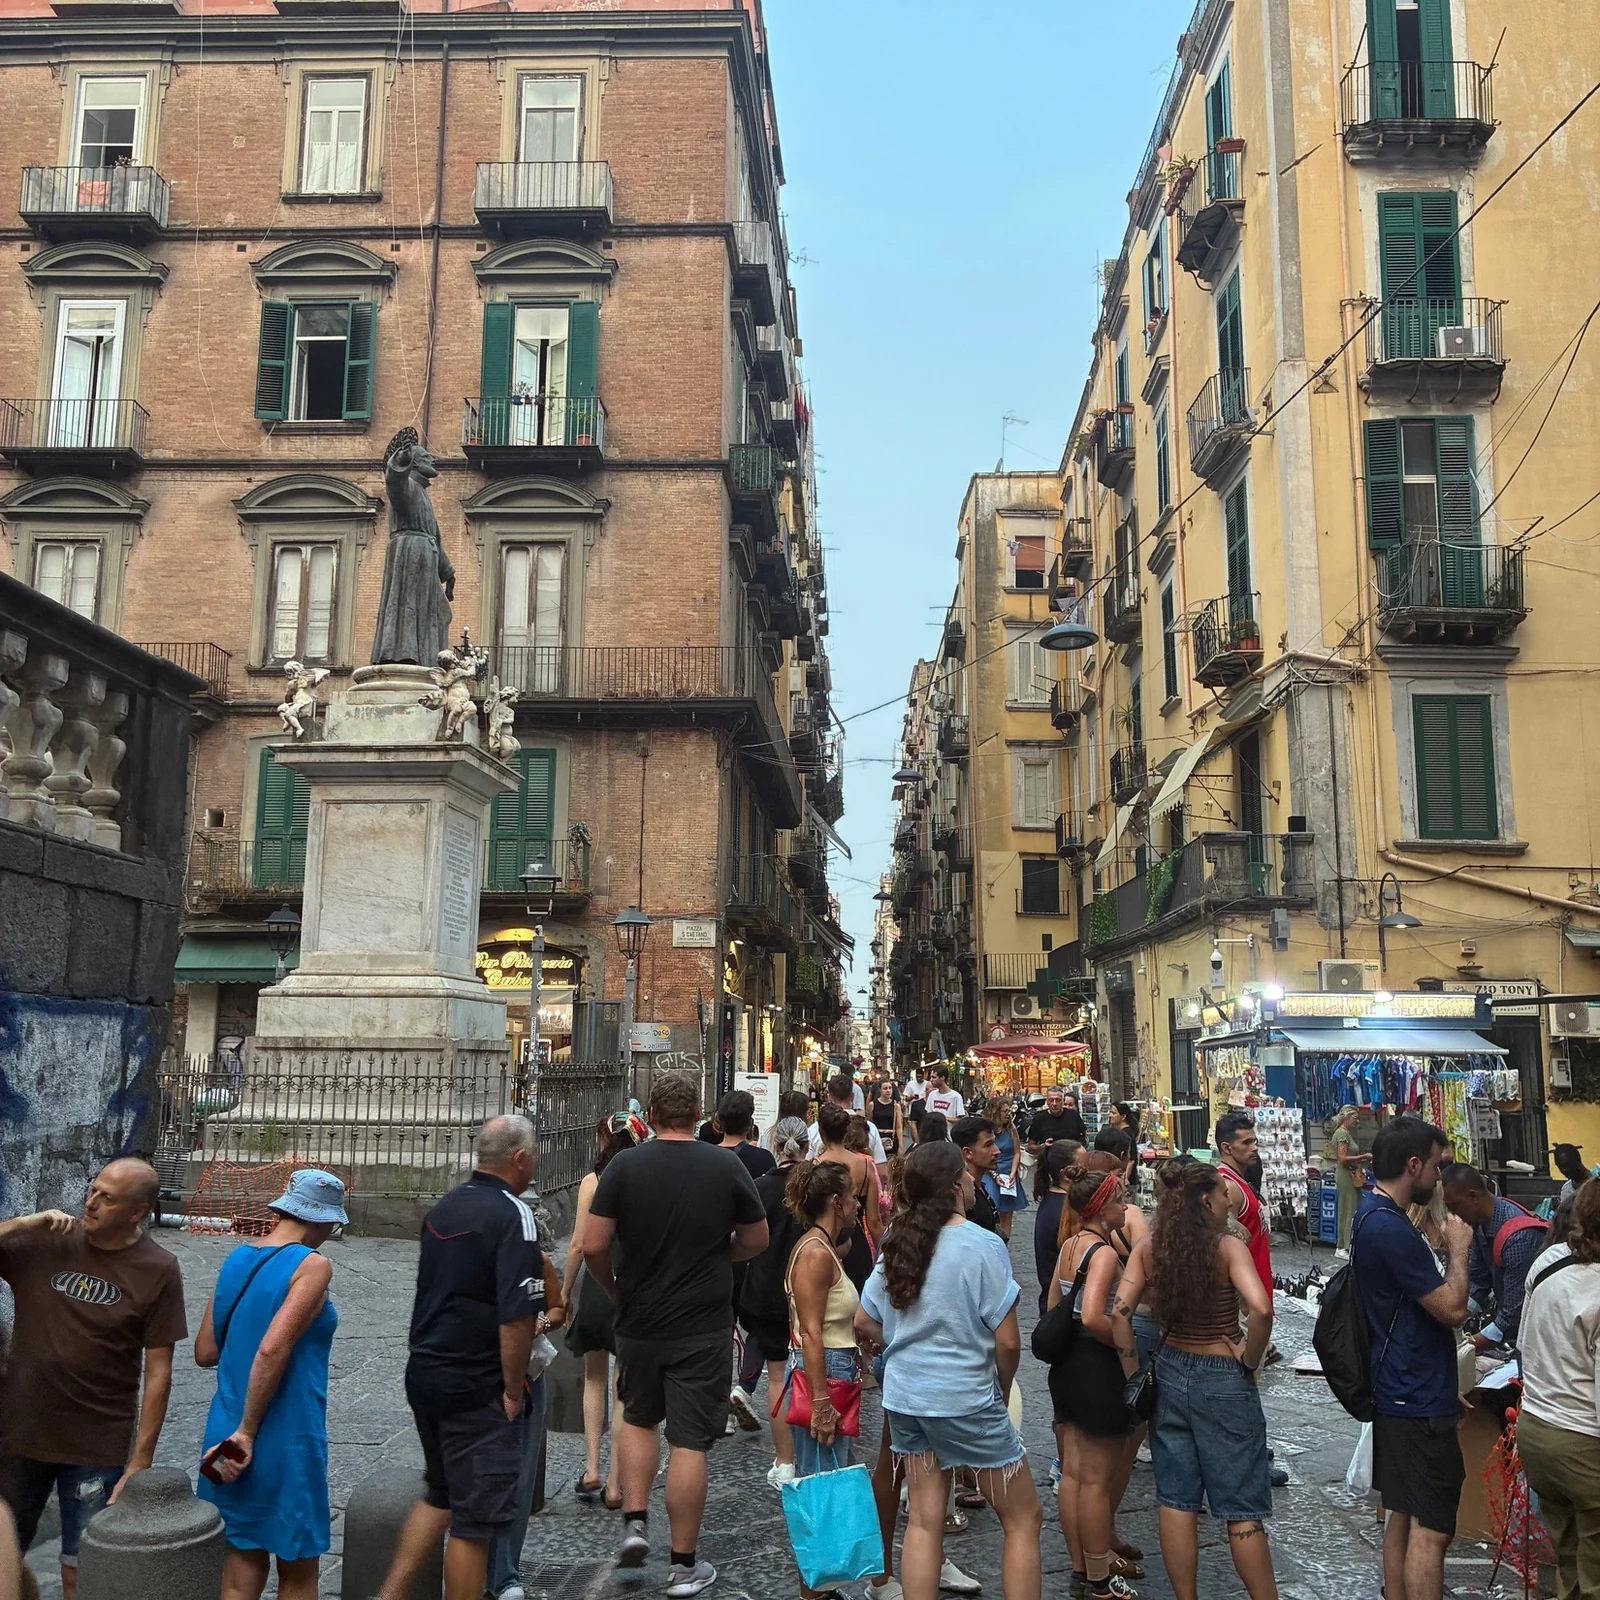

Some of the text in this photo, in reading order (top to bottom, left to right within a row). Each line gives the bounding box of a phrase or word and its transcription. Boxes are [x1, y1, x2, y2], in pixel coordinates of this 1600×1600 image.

[476, 951, 499, 969] Bar
[1475, 985, 1533, 996] ZIO TONY
[1322, 1192, 1336, 1233] DIEGO
